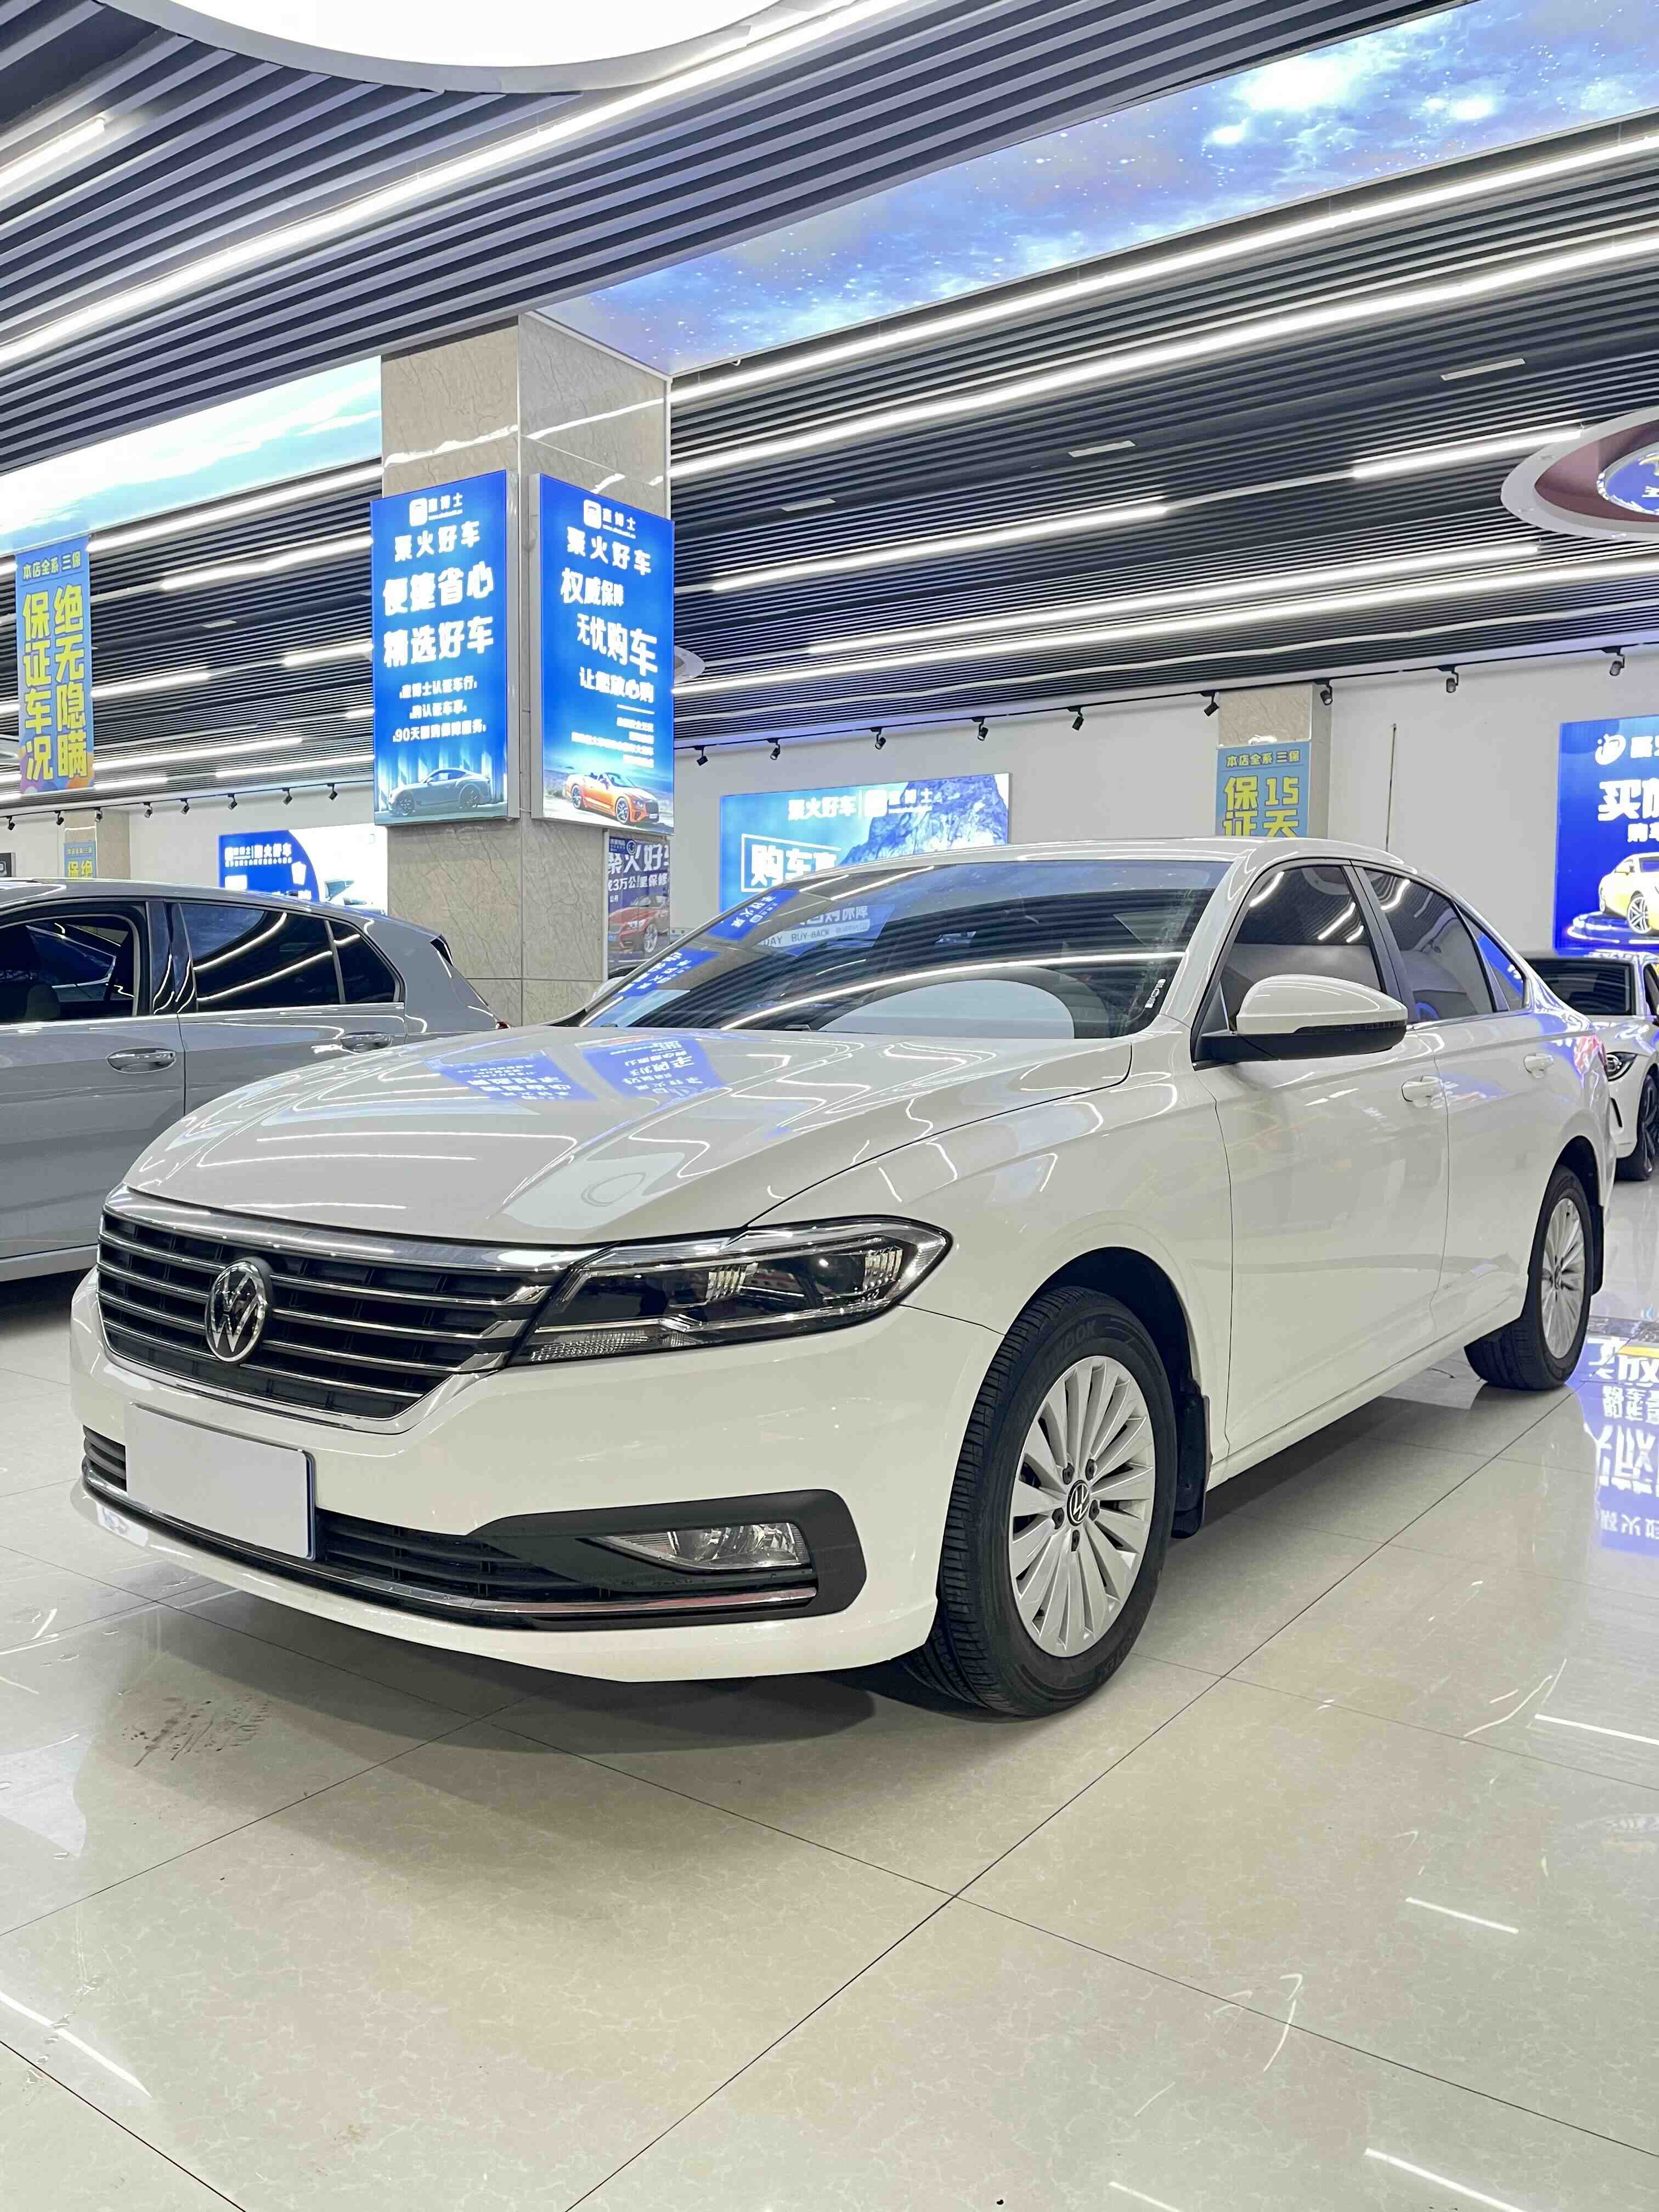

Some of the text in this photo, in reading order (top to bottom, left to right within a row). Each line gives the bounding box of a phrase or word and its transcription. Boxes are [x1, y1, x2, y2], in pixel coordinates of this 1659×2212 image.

[23, 556, 59, 579] 本店全系
[383, 561, 494, 616] 便捷省心
[561, 567, 624, 606] 权威保障
[383, 616, 494, 668] 精选好车
[577, 613, 658, 676] 无忧购车
[22, 590, 53, 781] 保证车况
[54, 584, 88, 778] 绝无隐瞒
[1227, 749, 1300, 767] 本店全系 三保
